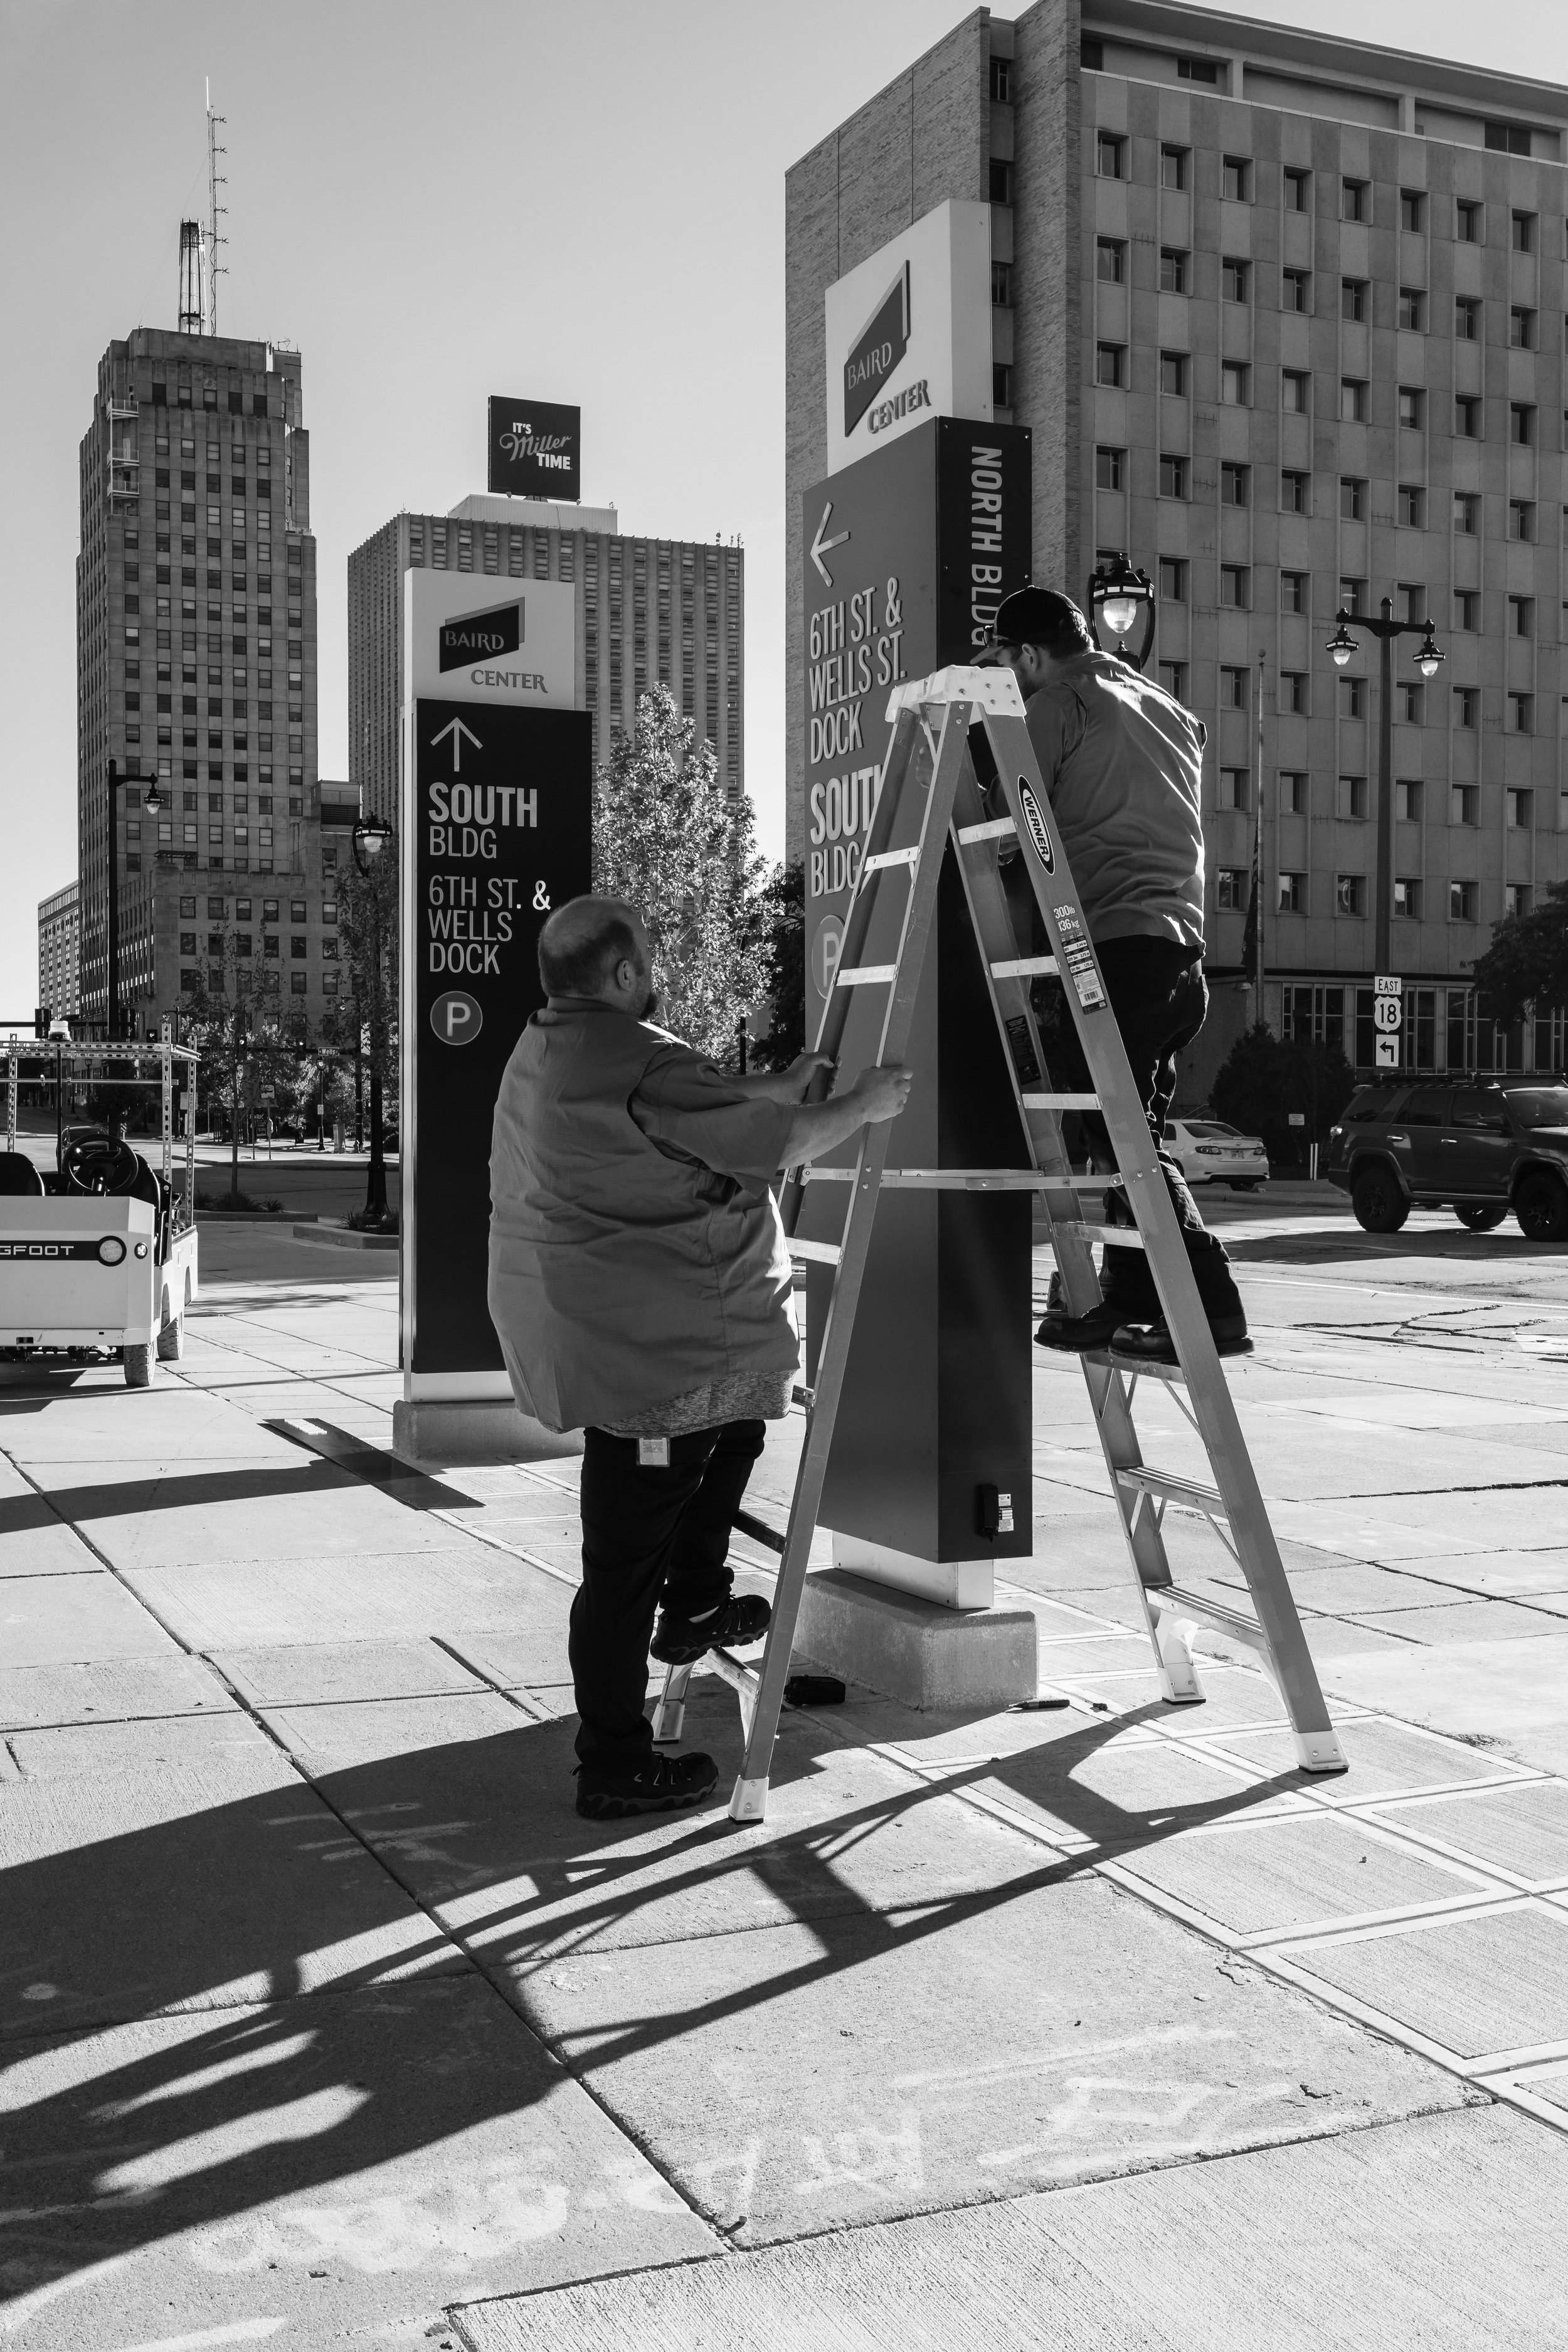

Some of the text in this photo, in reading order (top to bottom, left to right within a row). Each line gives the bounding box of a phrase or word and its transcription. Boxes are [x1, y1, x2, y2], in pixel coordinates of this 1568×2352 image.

[847, 342, 892, 390] BAIRD
[867, 379, 931, 433] CENTER
[512, 422, 532, 434] IT'S
[499, 433, 572, 462] Miller
[971, 446, 1002, 552] NORTH
[810, 577, 903, 660] 6TH ST. &
[445, 630, 504, 652] BAIRD
[470, 670, 548, 693] CENTER
[809, 630, 907, 712] WELLS ST.
[810, 701, 863, 764] DOCK
[428, 782, 538, 827] SOUTH
[810, 764, 883, 845] SOUT
[430, 825, 497, 859] BLDG
[1024, 796, 1049, 855] WERNER
[811, 840, 862, 898] BLDG
[429, 875, 551, 910] 6TH ST. &
[428, 909, 512, 941] WELLS
[430, 943, 501, 974] DOCK
[1379, 978, 1398, 992] EAST
[447, 1002, 471, 1037] P
[1380, 1004, 1397, 1024] 18
